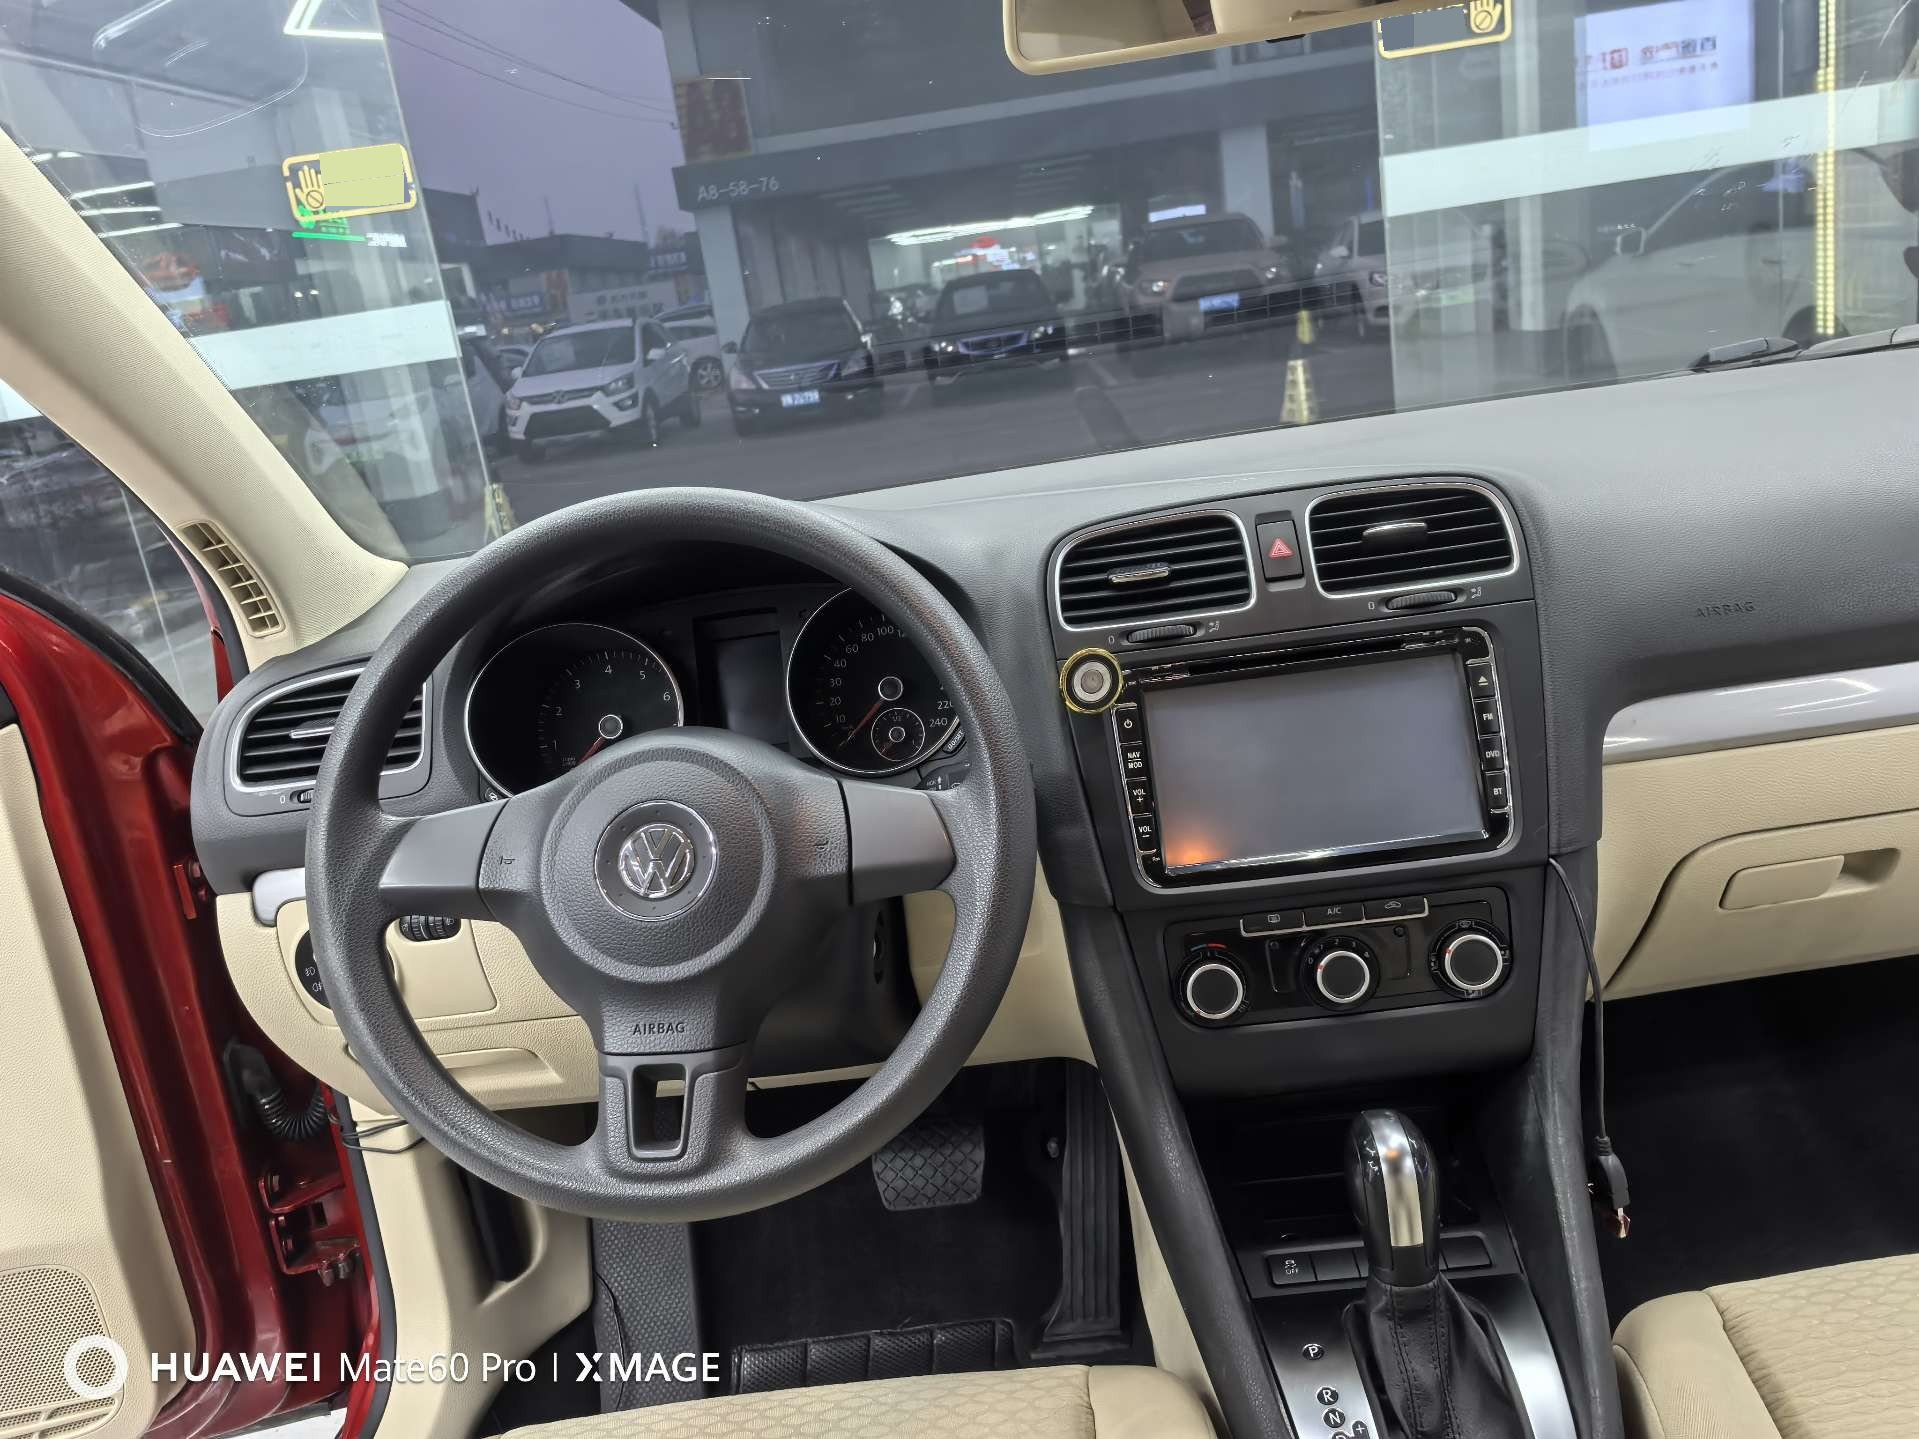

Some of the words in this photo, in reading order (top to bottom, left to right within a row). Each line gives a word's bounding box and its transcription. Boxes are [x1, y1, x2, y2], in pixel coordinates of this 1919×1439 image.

[697, 176, 779, 203] A8-58-76
[1695, 601, 1755, 618] AIRBAG
[877, 626, 895, 636] 100
[861, 632, 874, 642] 80
[845, 643, 859, 653] 60
[833, 659, 847, 668] 40
[604, 665, 612, 674] 4
[639, 671, 646, 680] 5
[575, 680, 581, 689] 3
[830, 678, 842, 687] 30
[663, 692, 671, 701] 6
[830, 697, 842, 706] 20
[556, 706, 563, 715] 2
[836, 714, 846, 723] 10
[1483, 713, 1494, 721] FM
[929, 717, 948, 728] 240
[1127, 761, 1143, 769] MOD
[1327, 906, 1342, 915] A/C
[632, 1022, 686, 1036] AIRBAG
[1308, 1345, 1319, 1358] P
[1322, 1389, 1335, 1403] R
[1328, 1411, 1341, 1425] N
